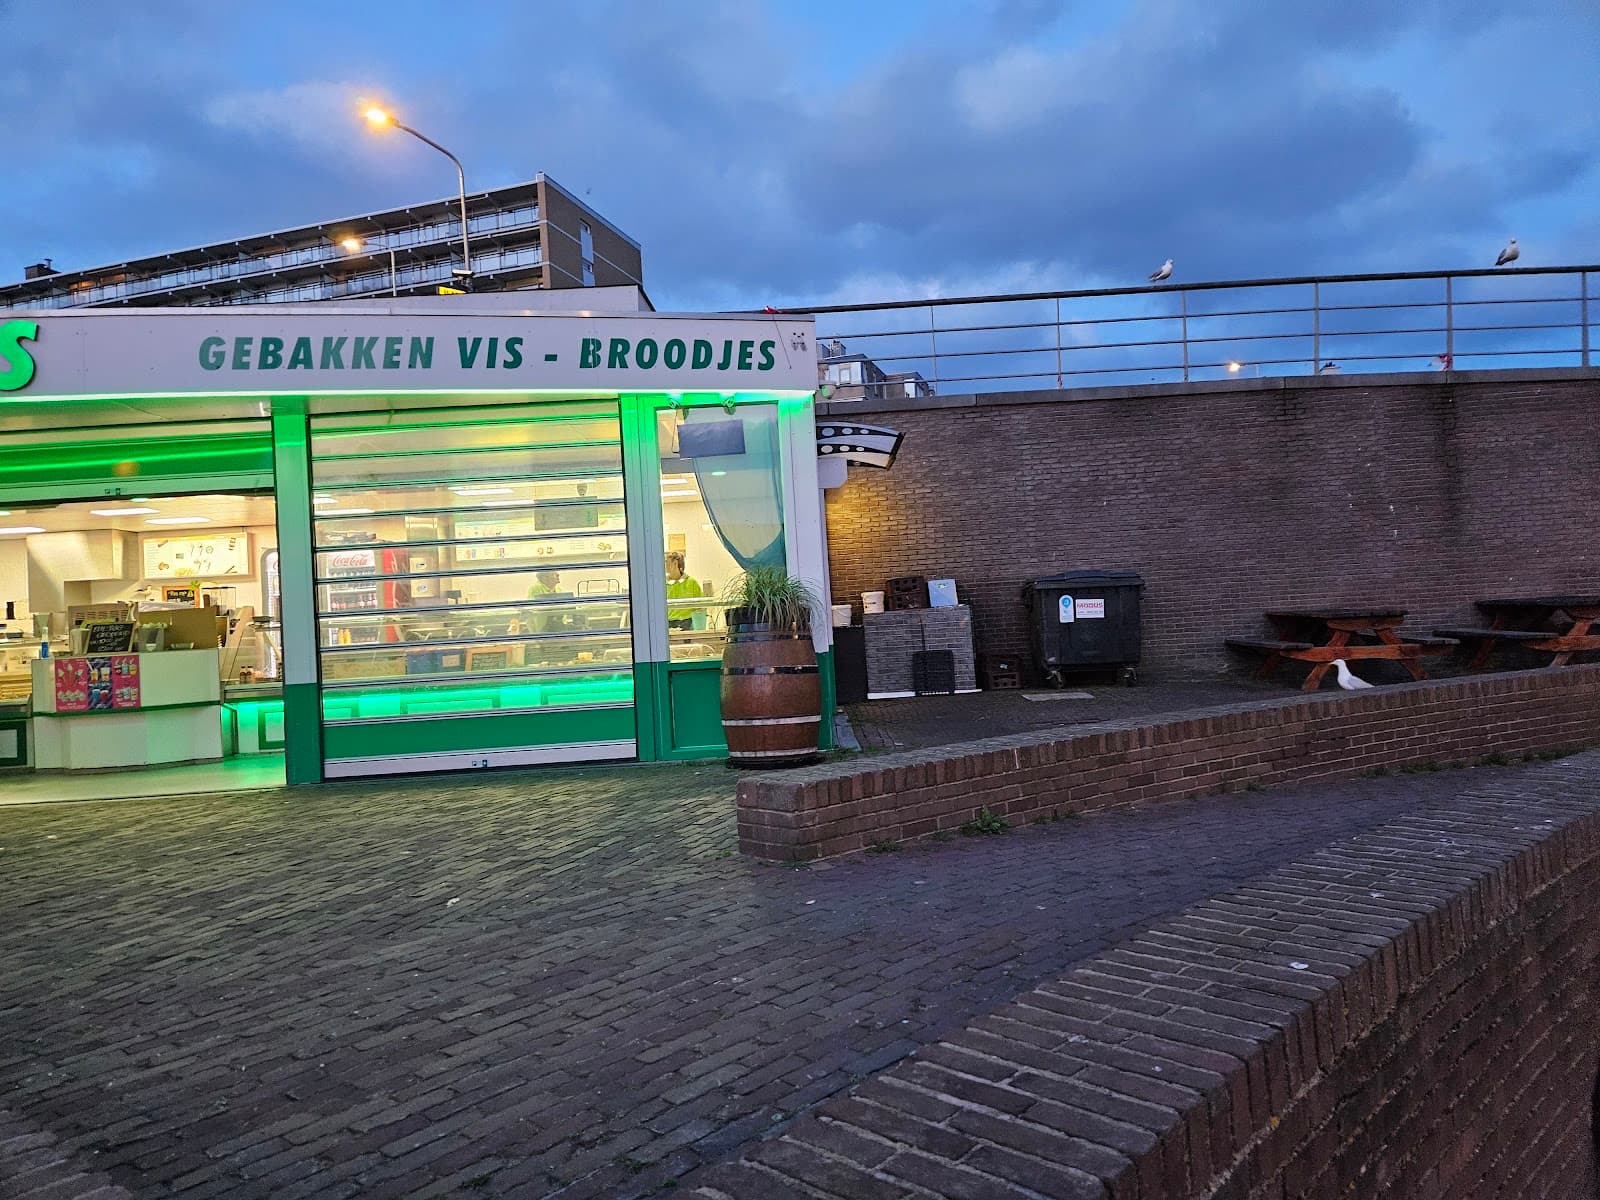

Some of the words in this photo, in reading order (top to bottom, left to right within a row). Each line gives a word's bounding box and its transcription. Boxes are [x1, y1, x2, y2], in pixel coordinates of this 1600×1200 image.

[198, 336, 435, 371] GEBAKKEN
[457, 336, 525, 370] VIS
[544, 354, 558, 362] -
[579, 337, 776, 371] BROODJES
